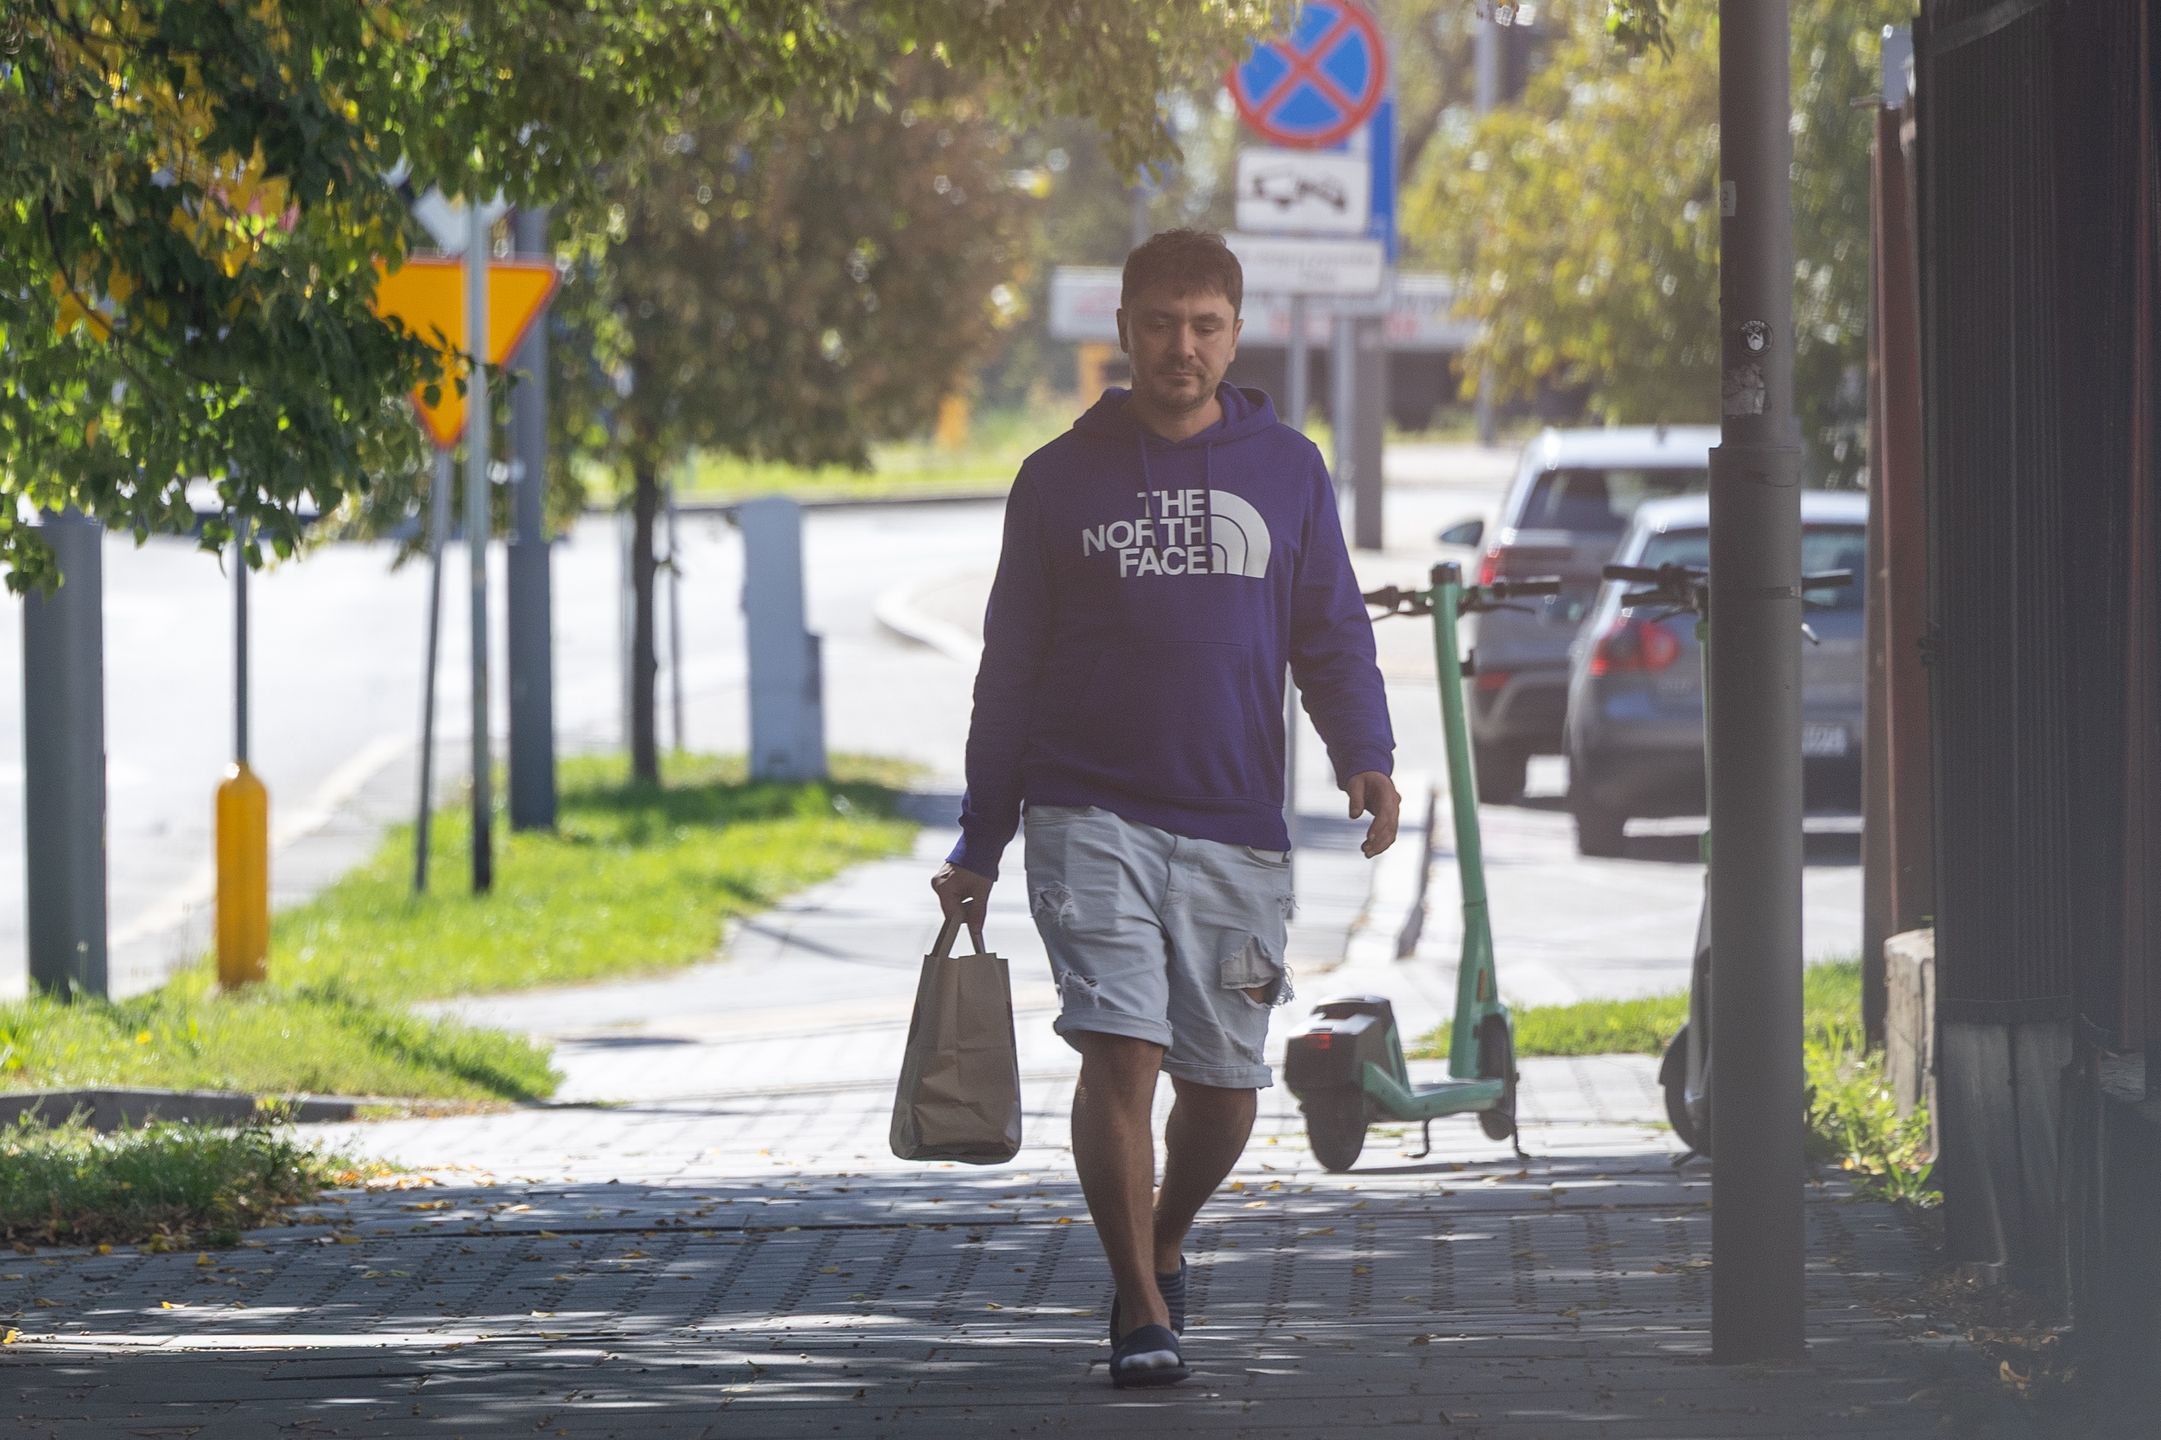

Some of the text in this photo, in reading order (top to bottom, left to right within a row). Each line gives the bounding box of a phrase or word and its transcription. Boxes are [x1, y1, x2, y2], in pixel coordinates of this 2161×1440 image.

[1137, 489, 1205, 518] THE
[1082, 517, 1205, 557] NORTH
[1119, 546, 1208, 578] FACE
